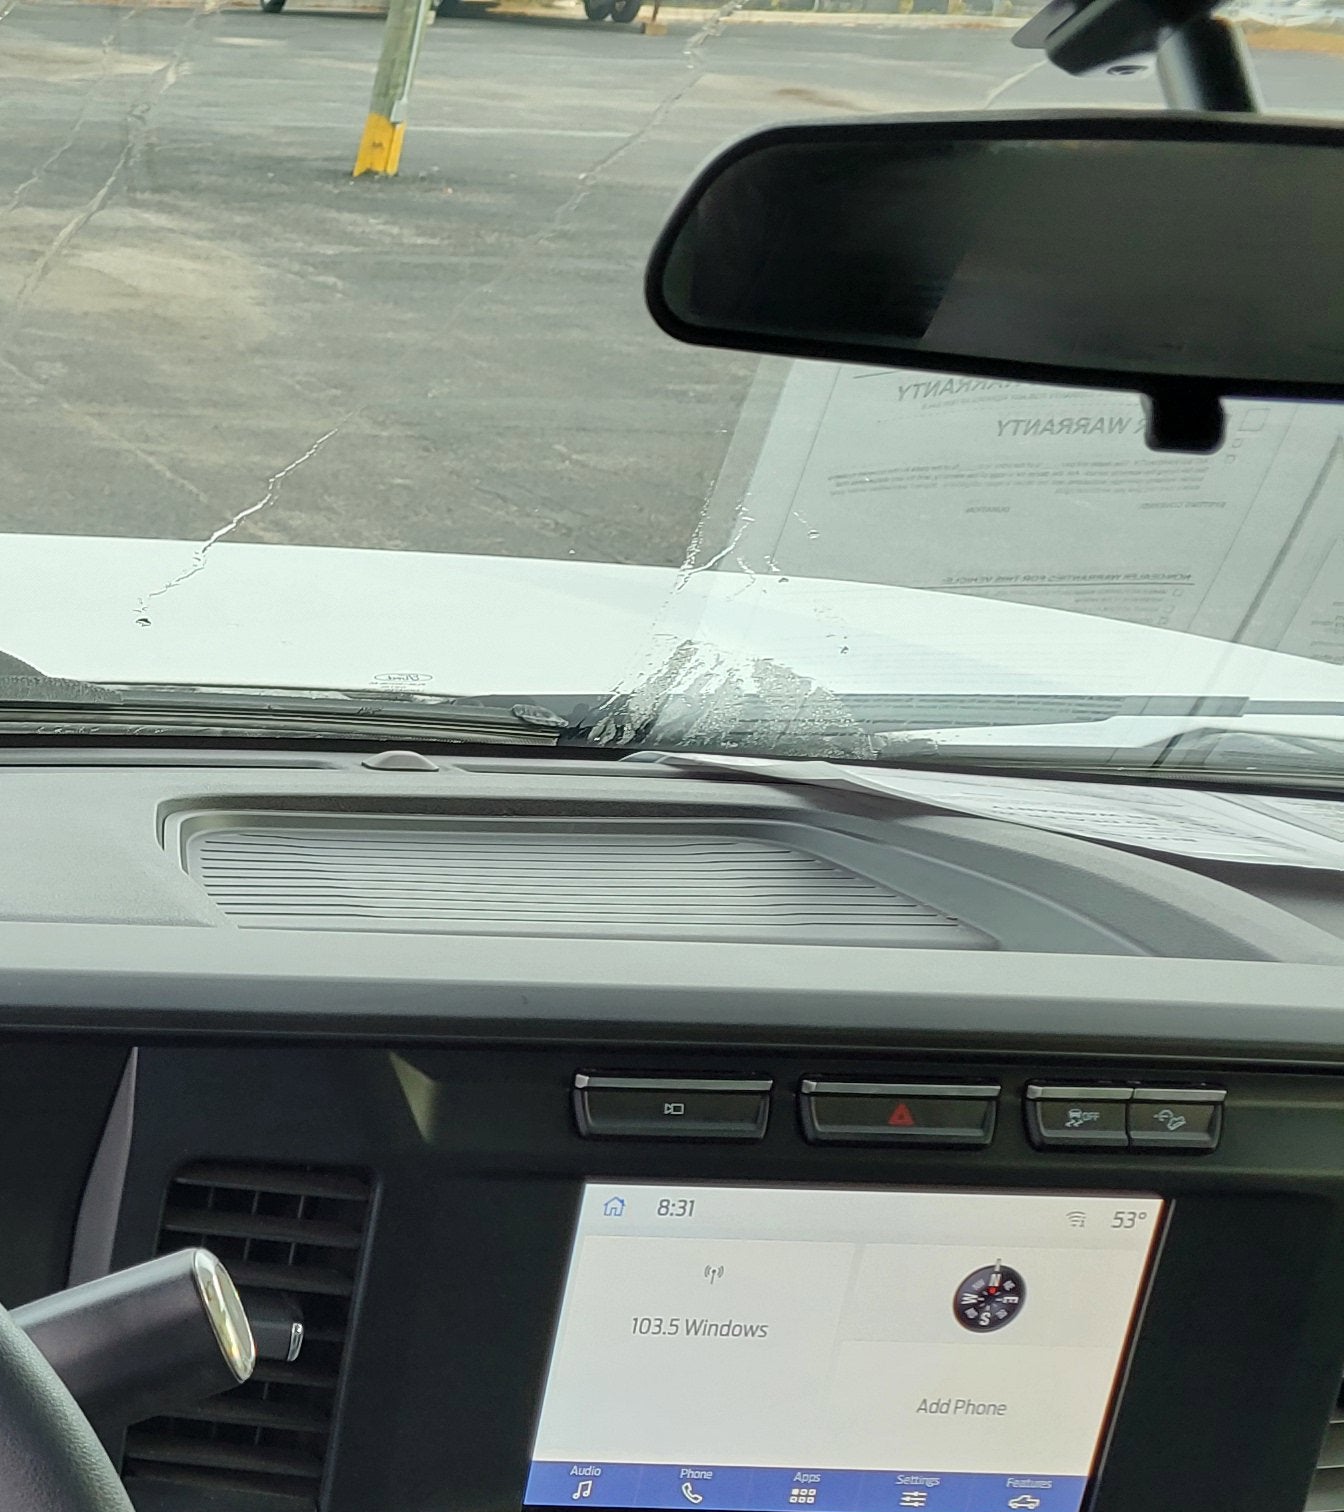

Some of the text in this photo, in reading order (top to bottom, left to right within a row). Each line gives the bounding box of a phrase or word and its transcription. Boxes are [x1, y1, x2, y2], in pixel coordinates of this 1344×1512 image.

[657, 1199, 695, 1217] 8:31
[1110, 1211, 1148, 1229] 53°
[979, 1312, 992, 1326] S
[632, 1317, 769, 1338] 103.5 Windows
[916, 1398, 1007, 1416] Add Phone
[570, 1465, 601, 1477] Audio
[679, 1468, 713, 1480] Phone
[793, 1471, 821, 1483] Apps
[895, 1474, 941, 1487] Settings
[1006, 1477, 1053, 1489] Features
